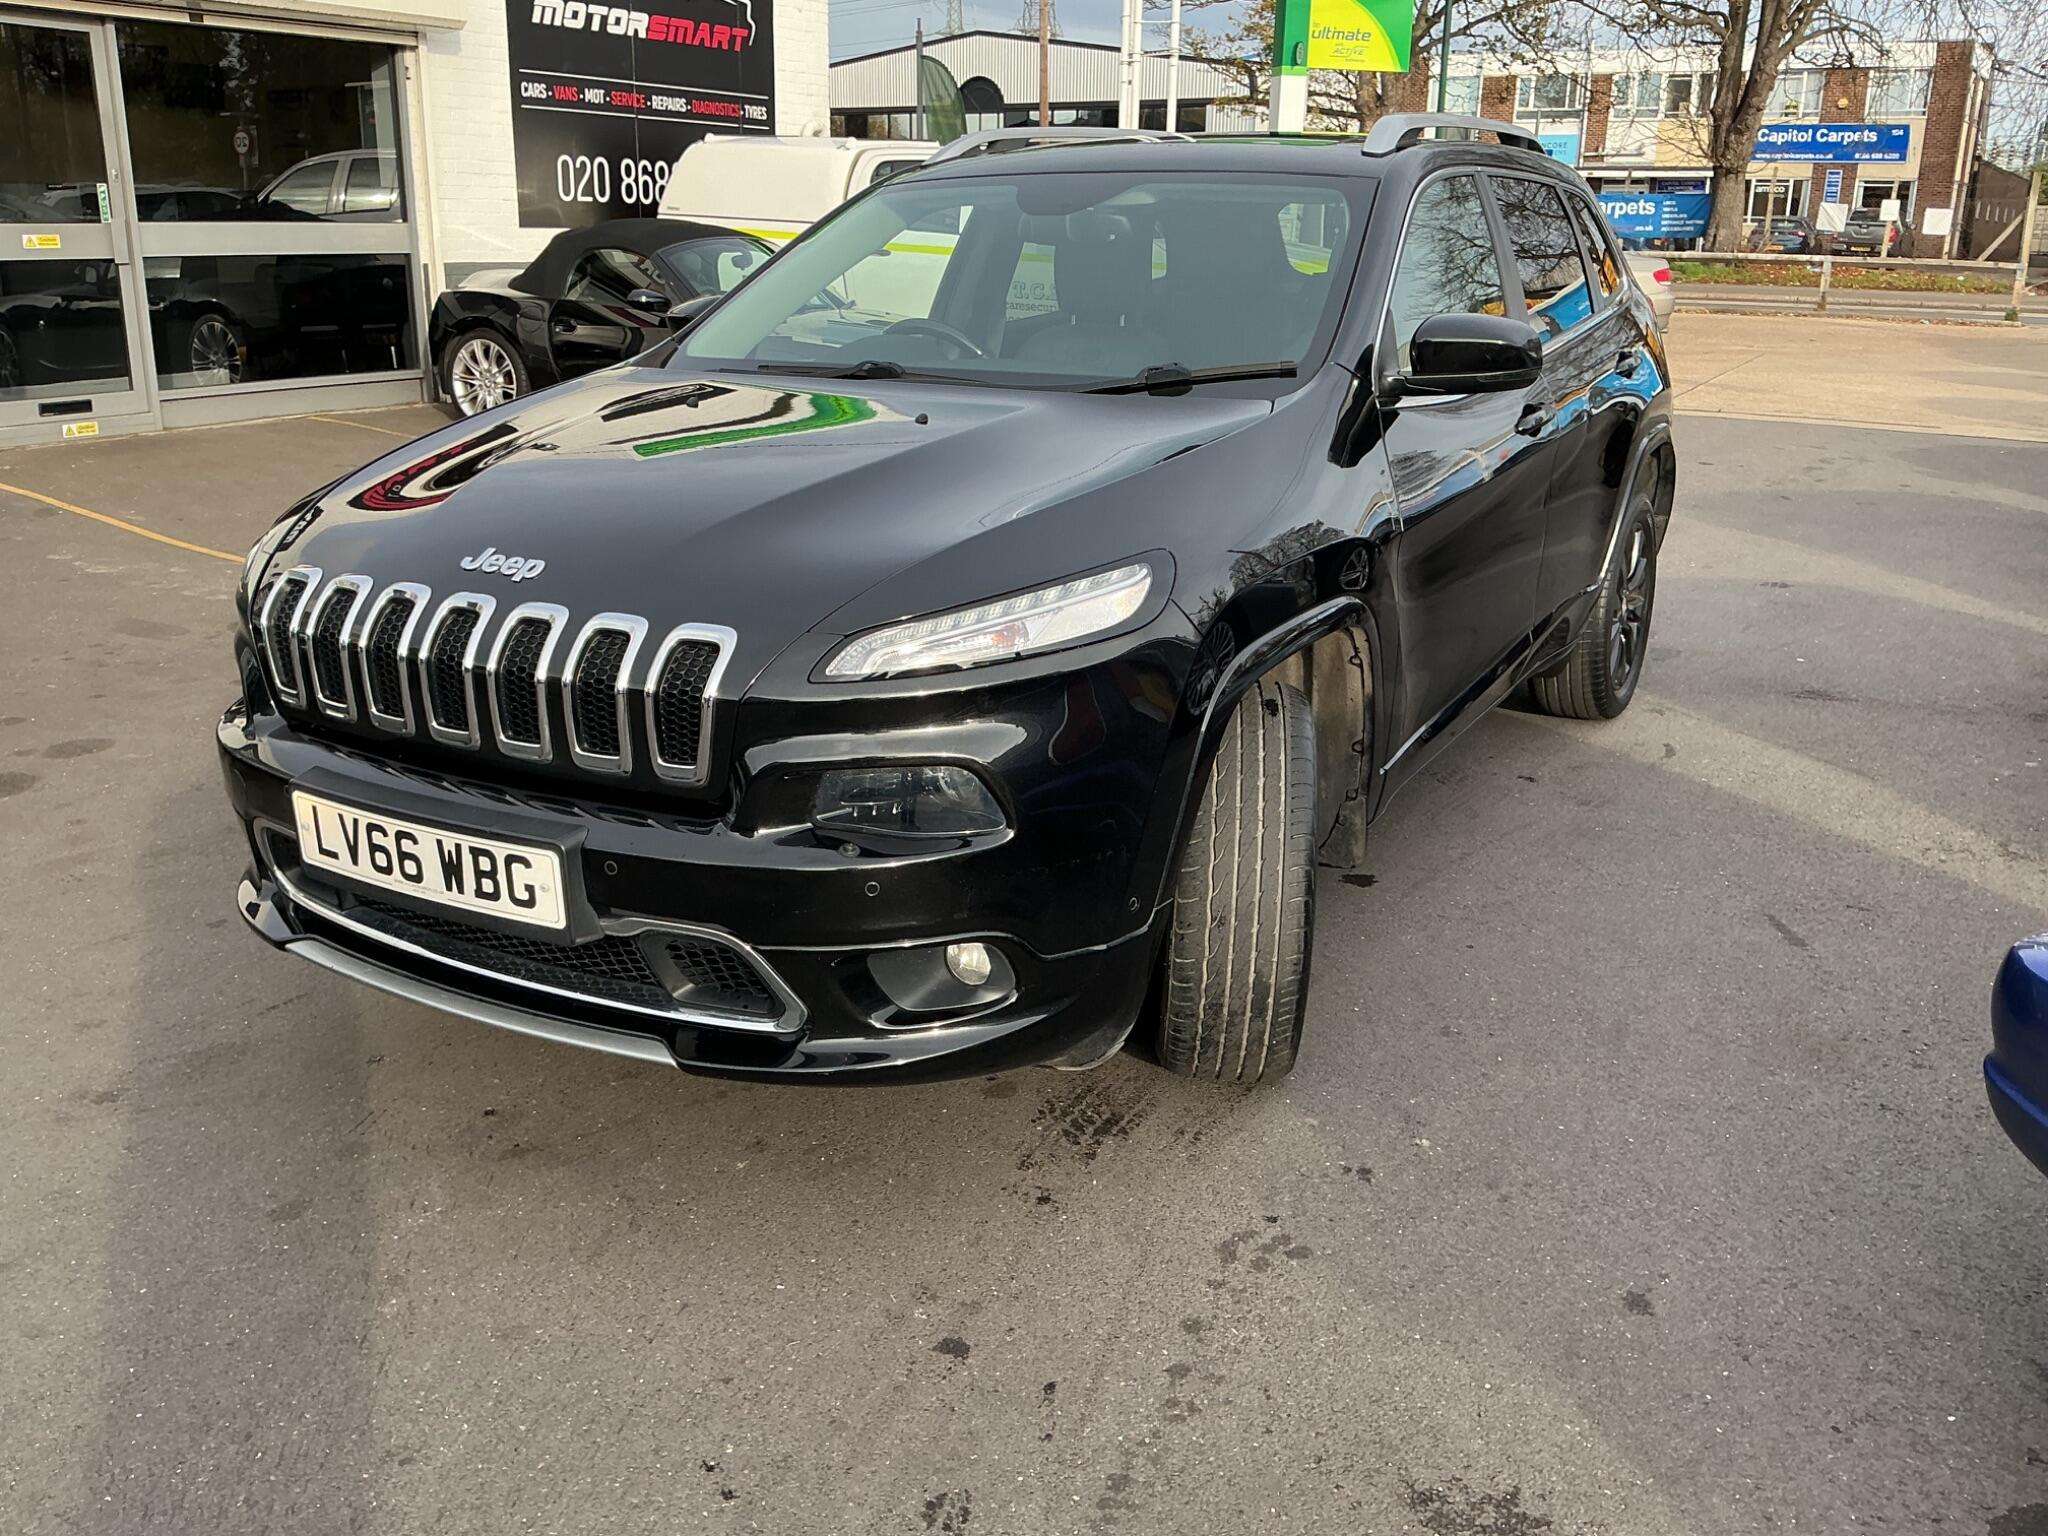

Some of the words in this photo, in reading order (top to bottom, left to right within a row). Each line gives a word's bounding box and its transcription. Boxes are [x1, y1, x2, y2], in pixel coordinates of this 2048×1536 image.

[531, 0, 749, 52] MOTORSMART
[1311, 25, 1371, 42] ultimate
[520, 82, 547, 99] CARS
[553, 85, 578, 101] VANS
[584, 90, 605, 105] MOT
[610, 91, 646, 109] SERVICE
[652, 96, 687, 112] REPAIRS
[692, 101, 740, 118] DIAGNOSTICS
[744, 104, 768, 120] TYRES
[1757, 128, 1813, 145] Capitol
[1820, 129, 1878, 145] Carpets
[557, 154, 610, 203] 020
[460, 547, 546, 583] Jeep
[311, 805, 424, 884] LV66
[436, 838, 536, 909] WBG
